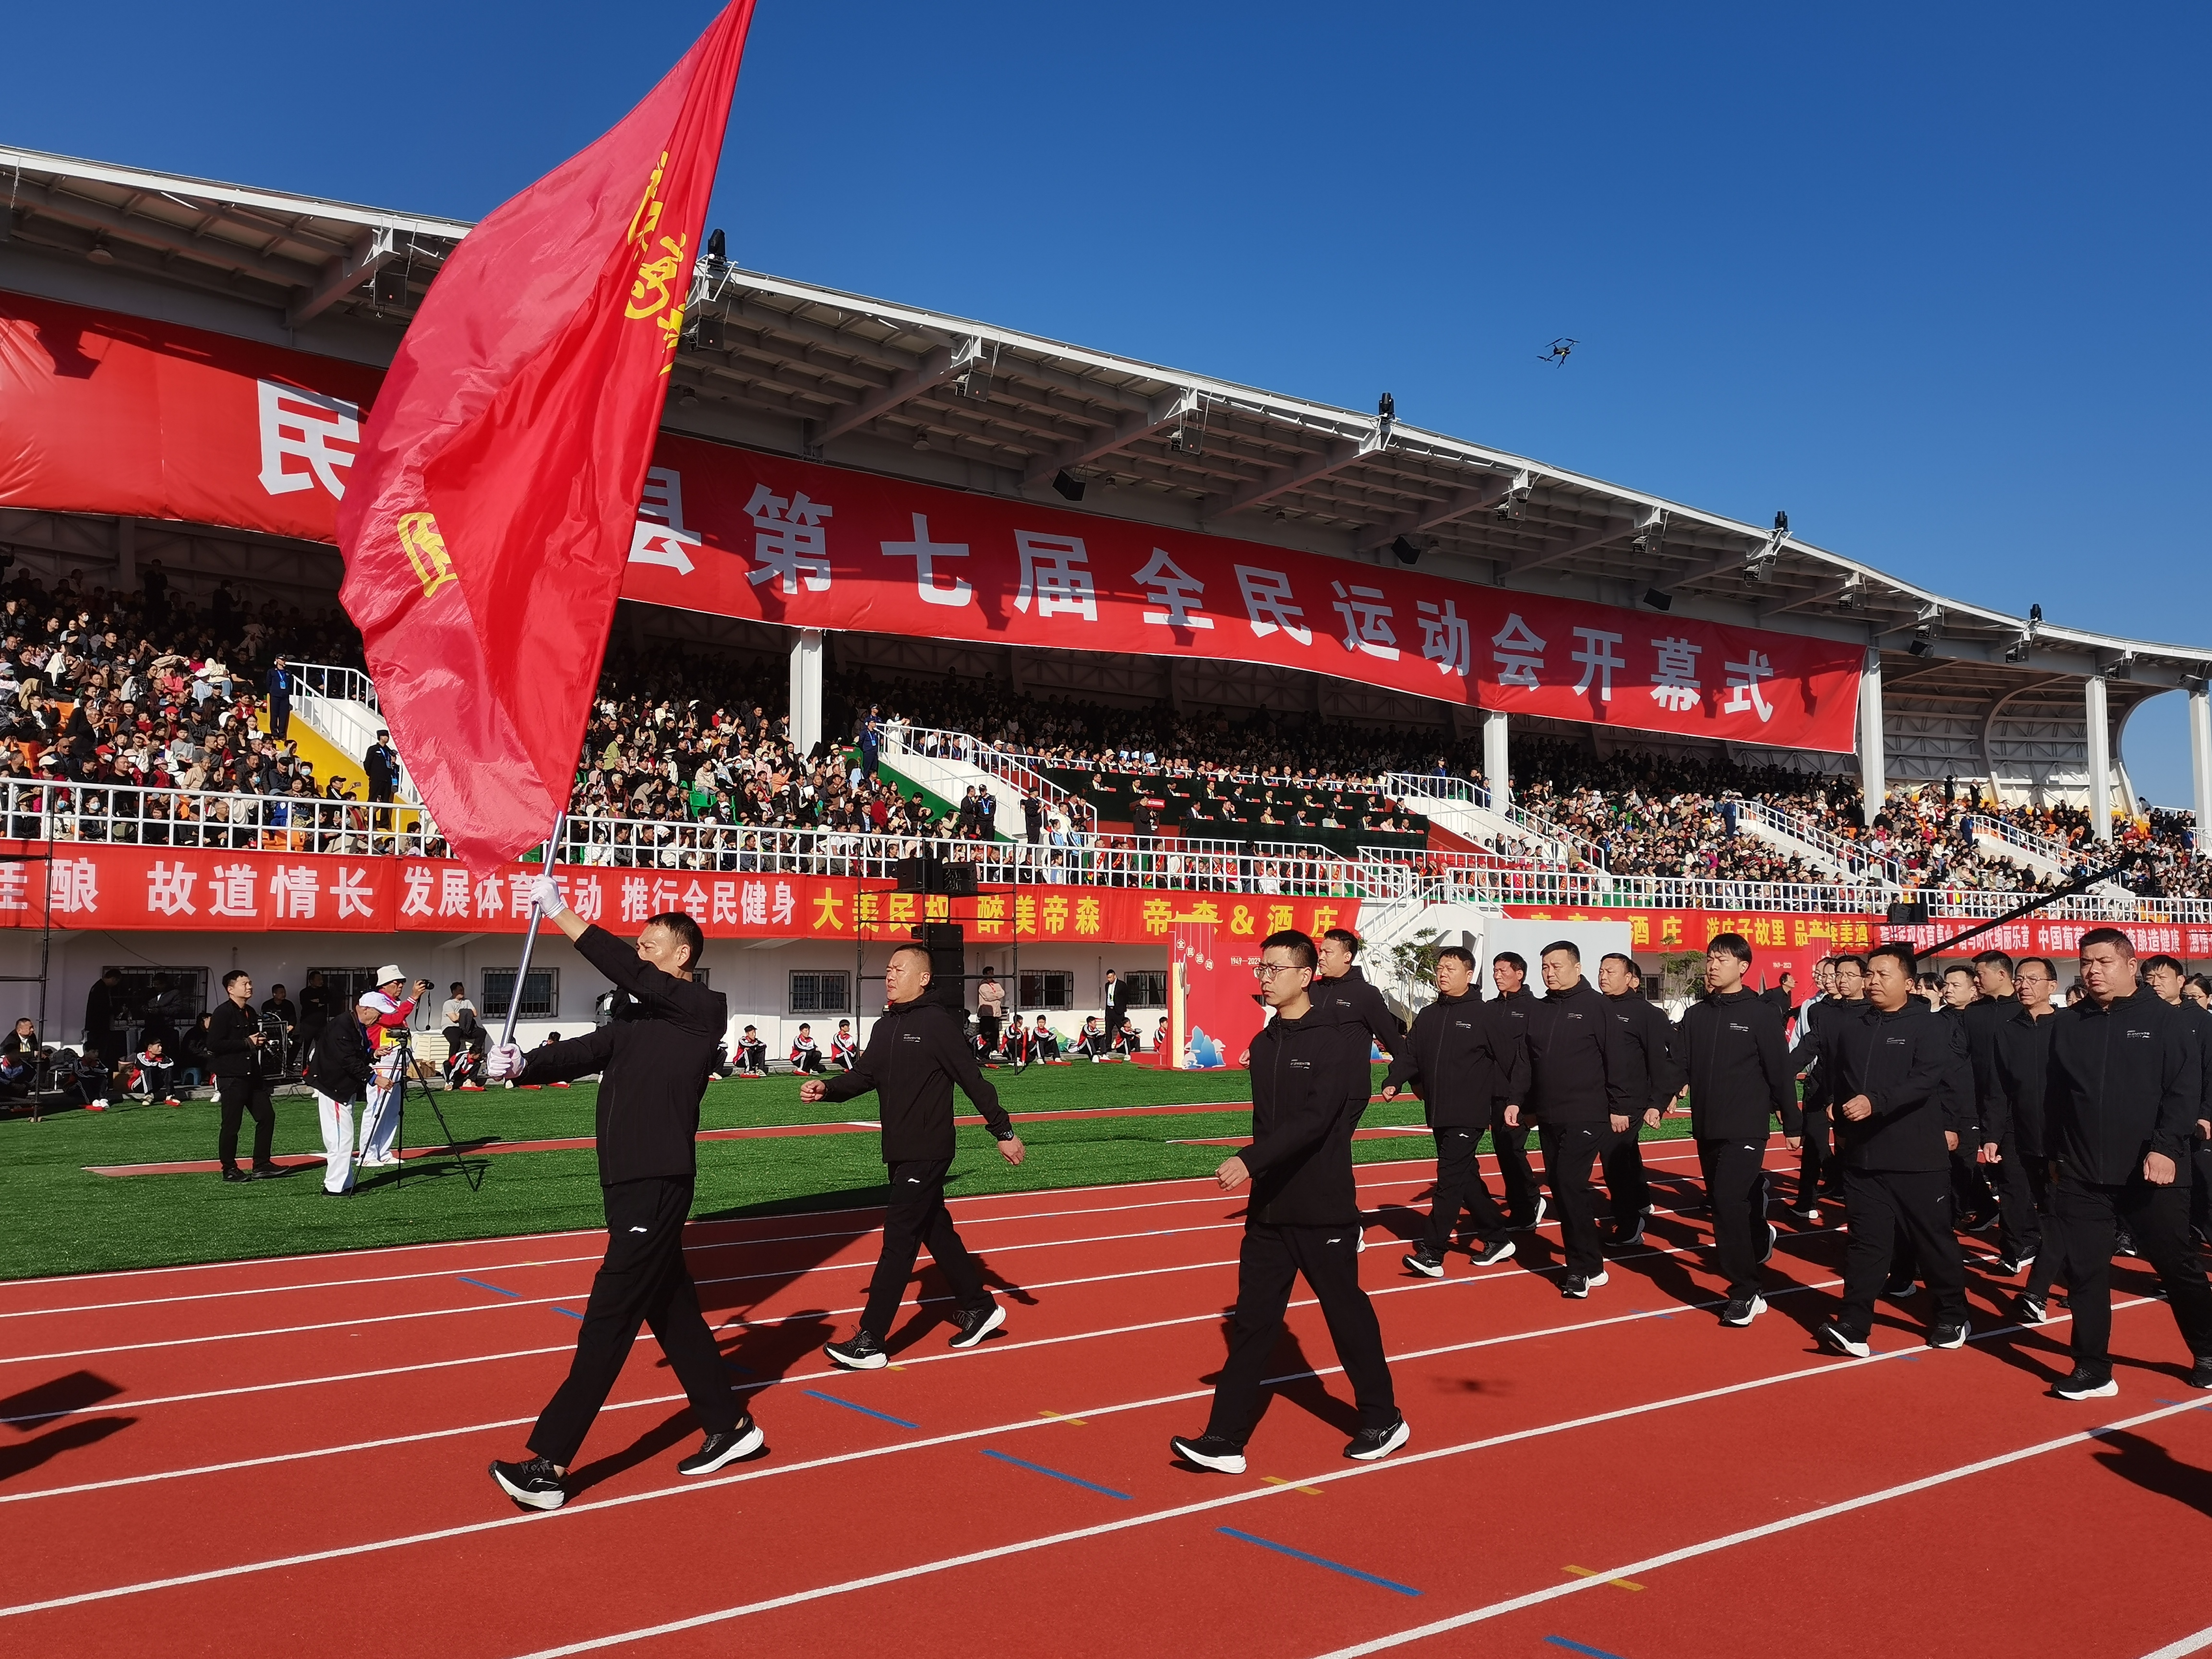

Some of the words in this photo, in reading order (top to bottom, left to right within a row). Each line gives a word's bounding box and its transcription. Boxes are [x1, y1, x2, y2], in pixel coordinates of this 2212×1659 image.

[147, 861, 373, 919] 故道情长
[621, 876, 795, 925] 推行全民健身
[977, 894, 1100, 935] 醉美帝森
